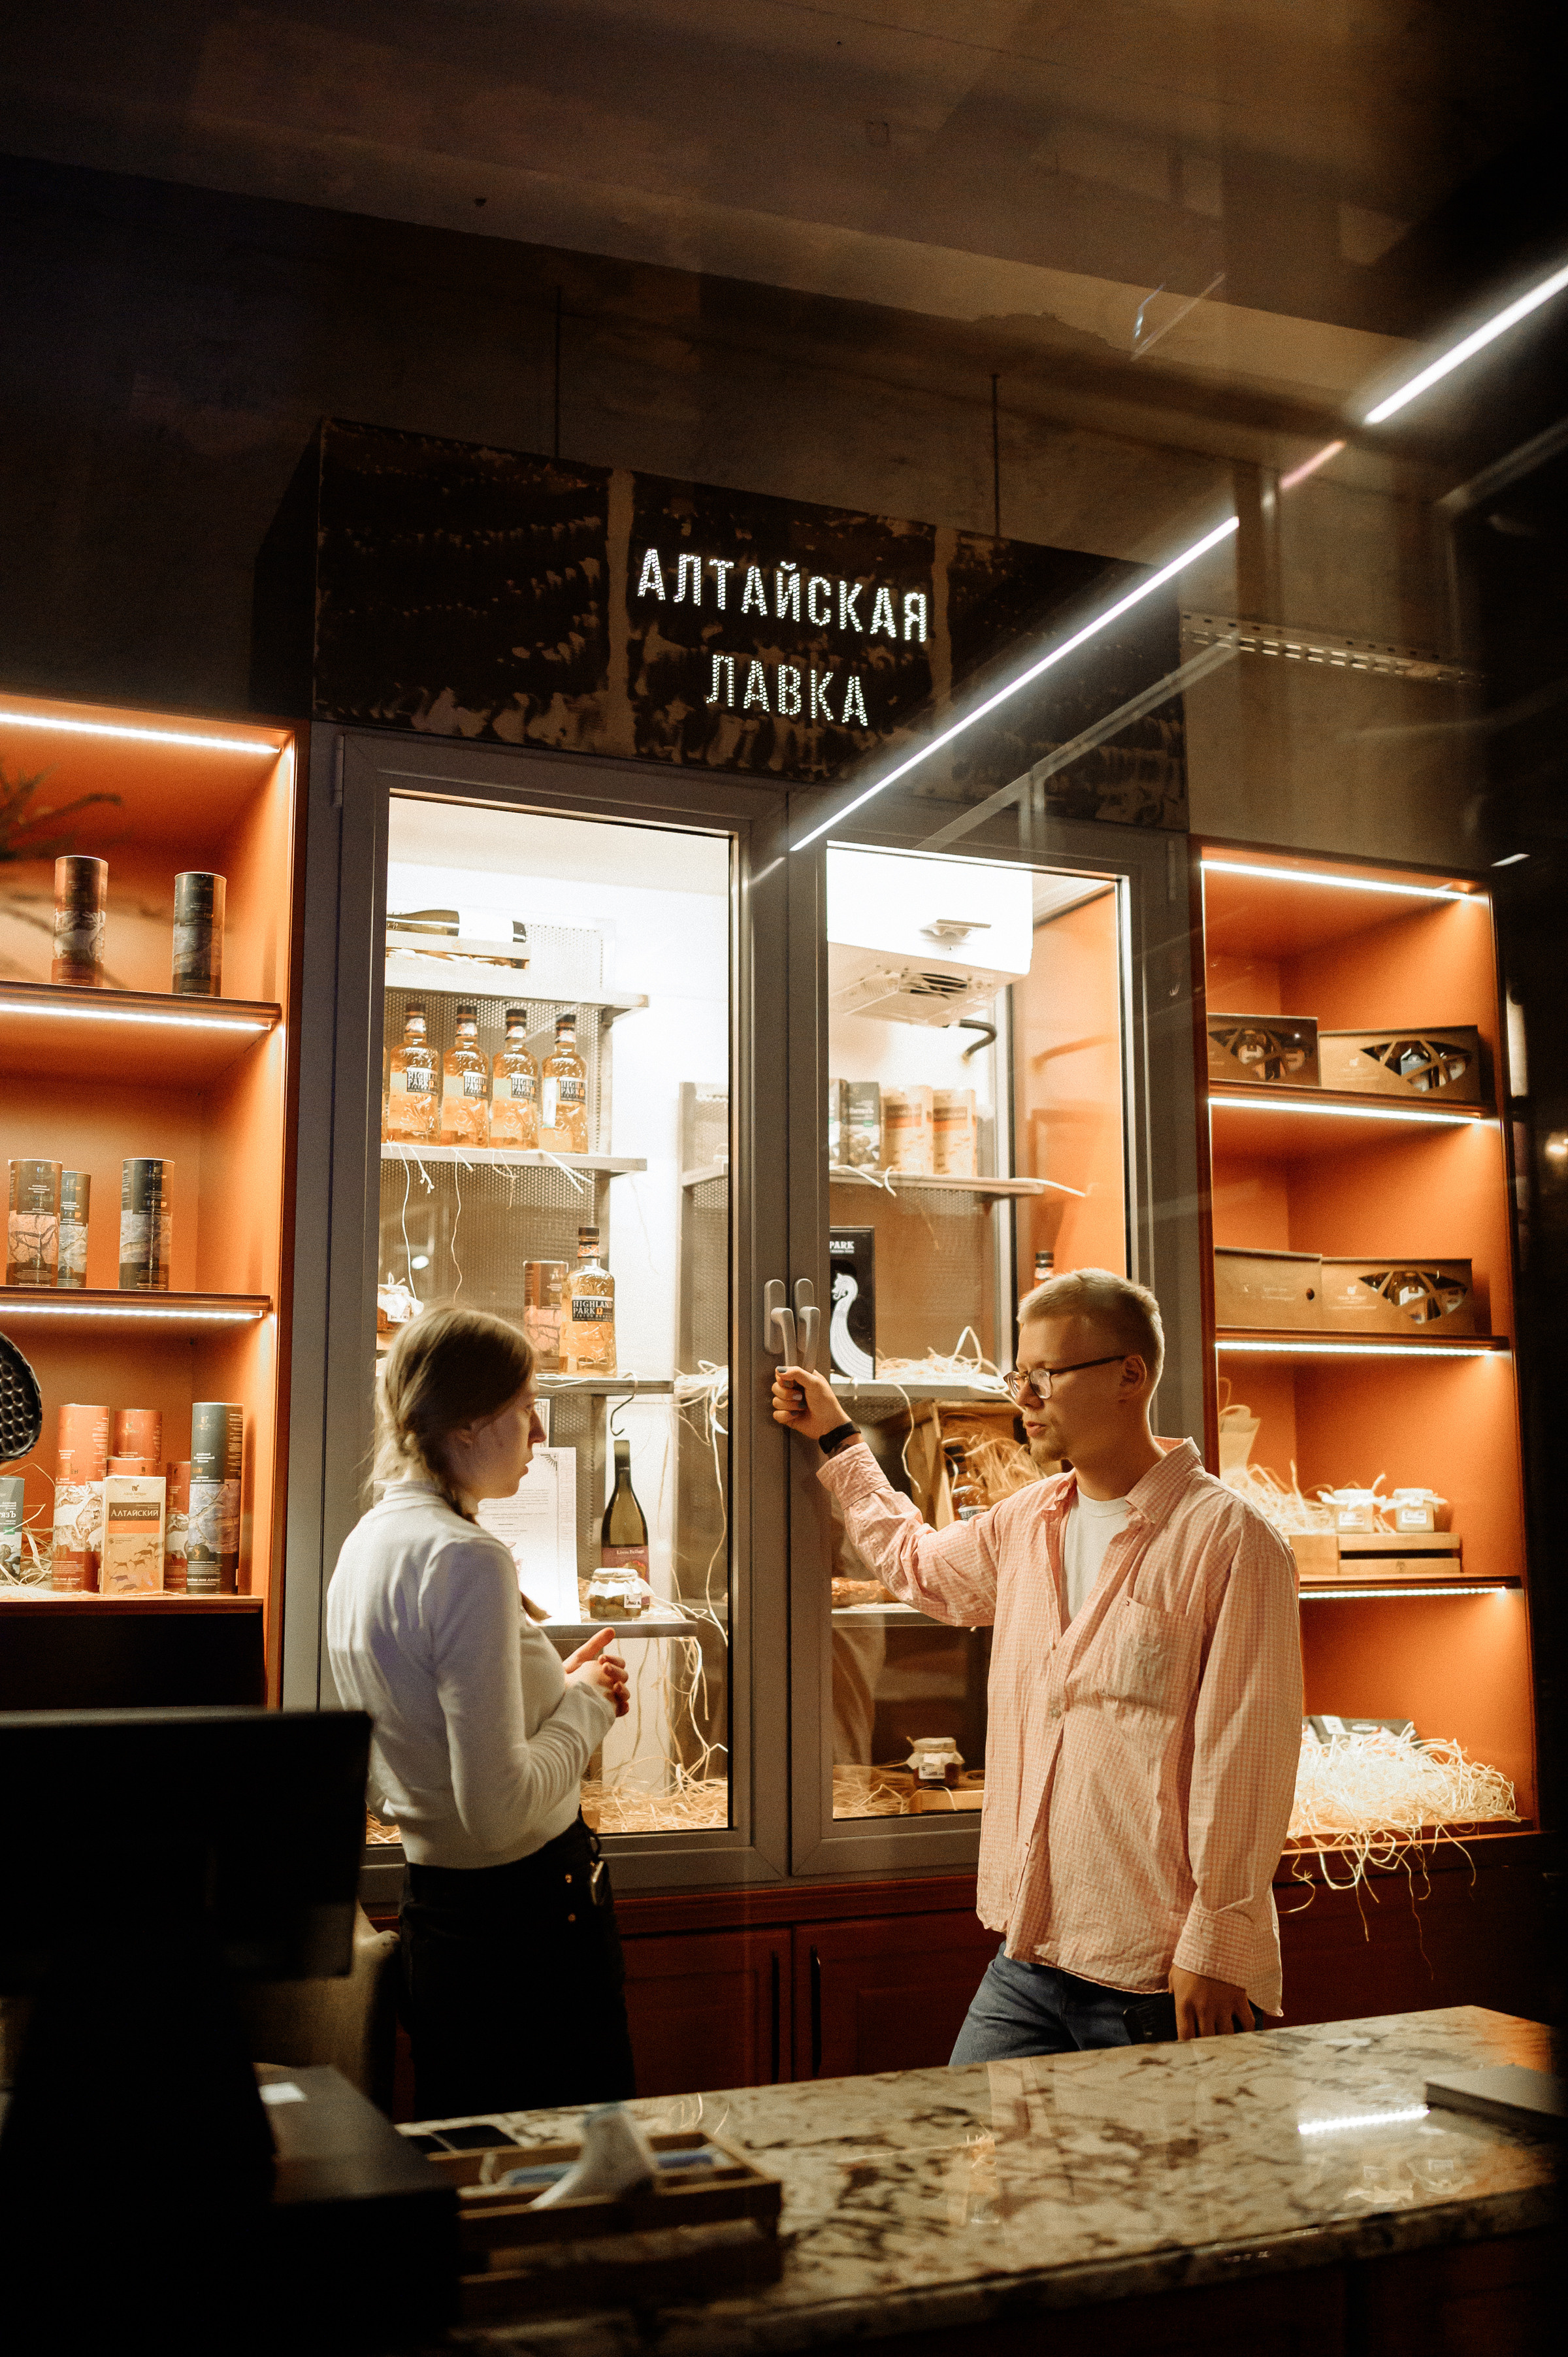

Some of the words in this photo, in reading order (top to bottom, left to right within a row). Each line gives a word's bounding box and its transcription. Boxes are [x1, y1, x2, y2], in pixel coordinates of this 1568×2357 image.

[637, 548, 927, 642] АЛТАЙСКАЯ
[706, 654, 868, 727] ЛАВКА
[465, 1083, 483, 1091] PARK
[829, 1241, 855, 1249] PARK
